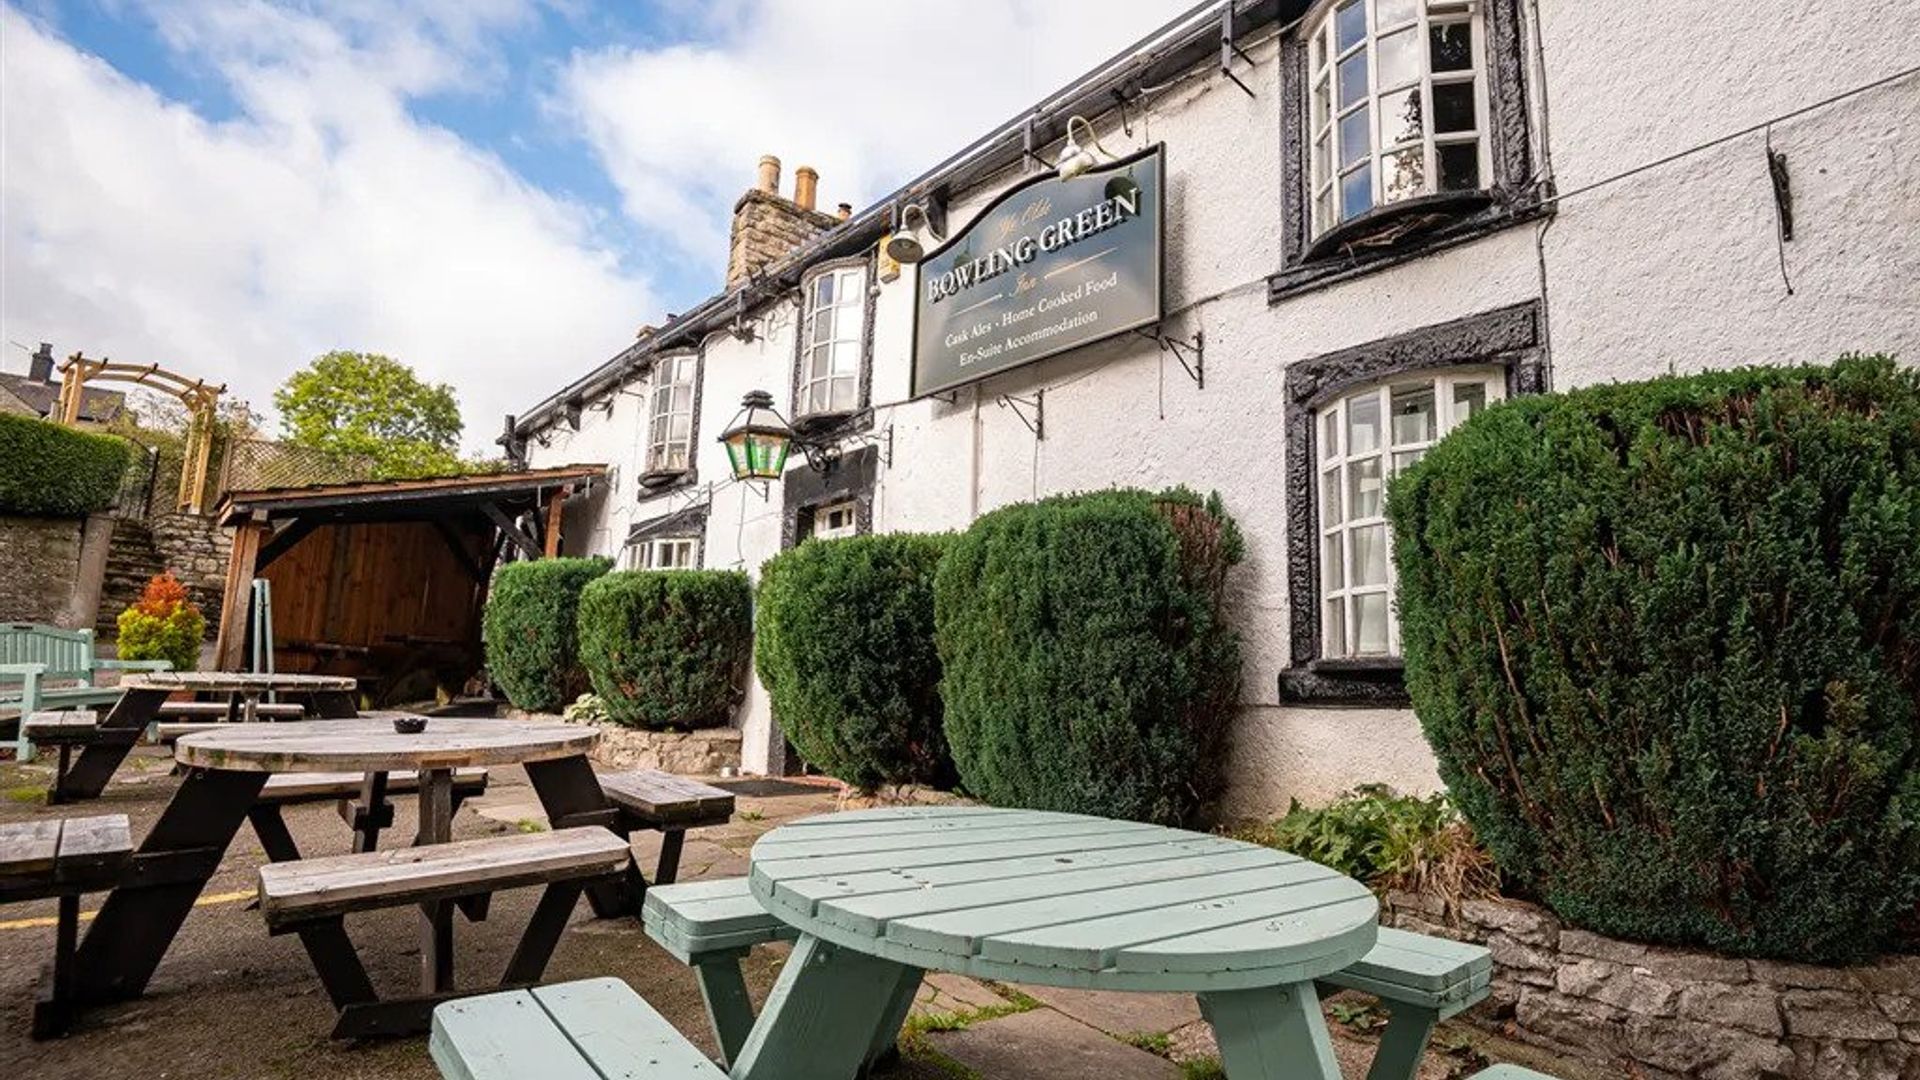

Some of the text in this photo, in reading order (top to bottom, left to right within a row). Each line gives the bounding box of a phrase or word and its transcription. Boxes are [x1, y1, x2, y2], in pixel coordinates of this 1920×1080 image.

[928, 187, 1138, 303] BOWLING GREEN
[945, 271, 1117, 348] Cask Ales Home Cooked Food
[960, 311, 1098, 367] En-Suite Accommodation
